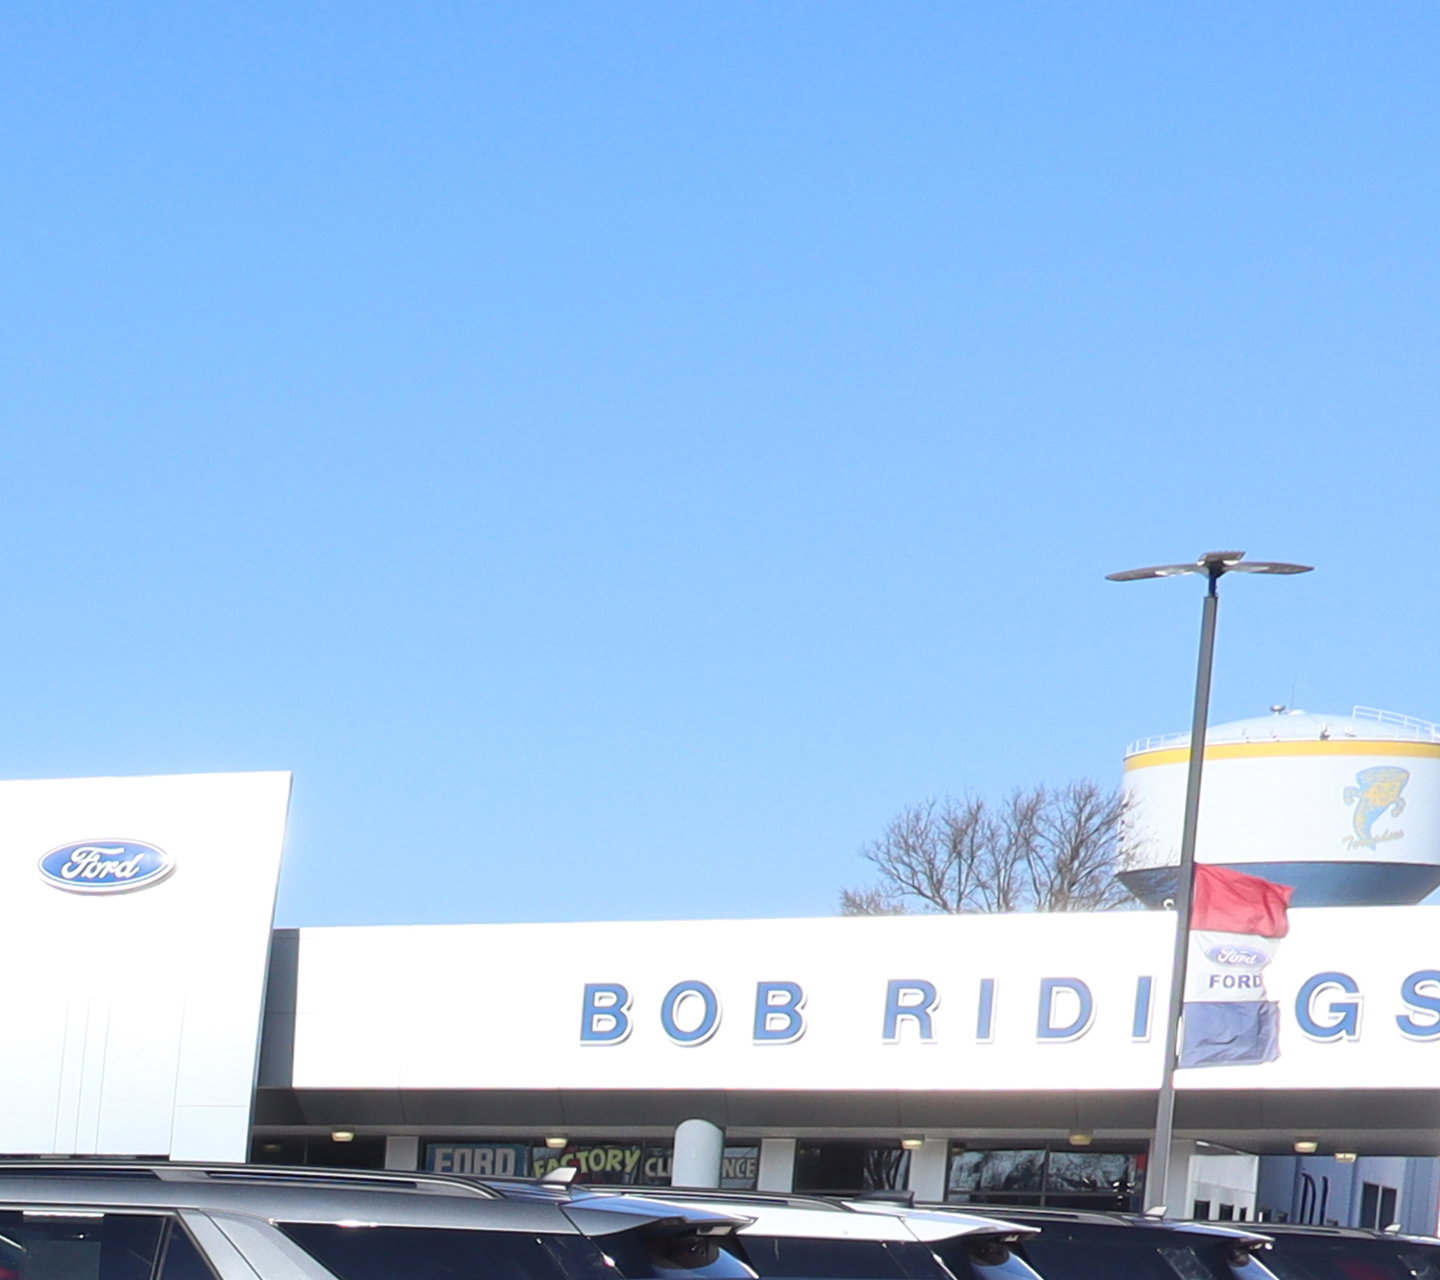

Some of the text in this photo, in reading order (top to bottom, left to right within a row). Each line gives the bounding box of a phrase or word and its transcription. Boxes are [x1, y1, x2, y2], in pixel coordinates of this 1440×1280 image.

[61, 846, 145, 879] Ford
[1209, 974, 1263, 989] FORD
[579, 971, 1440, 1047] BOB RIDIGS
[435, 1148, 516, 1176] FORD
